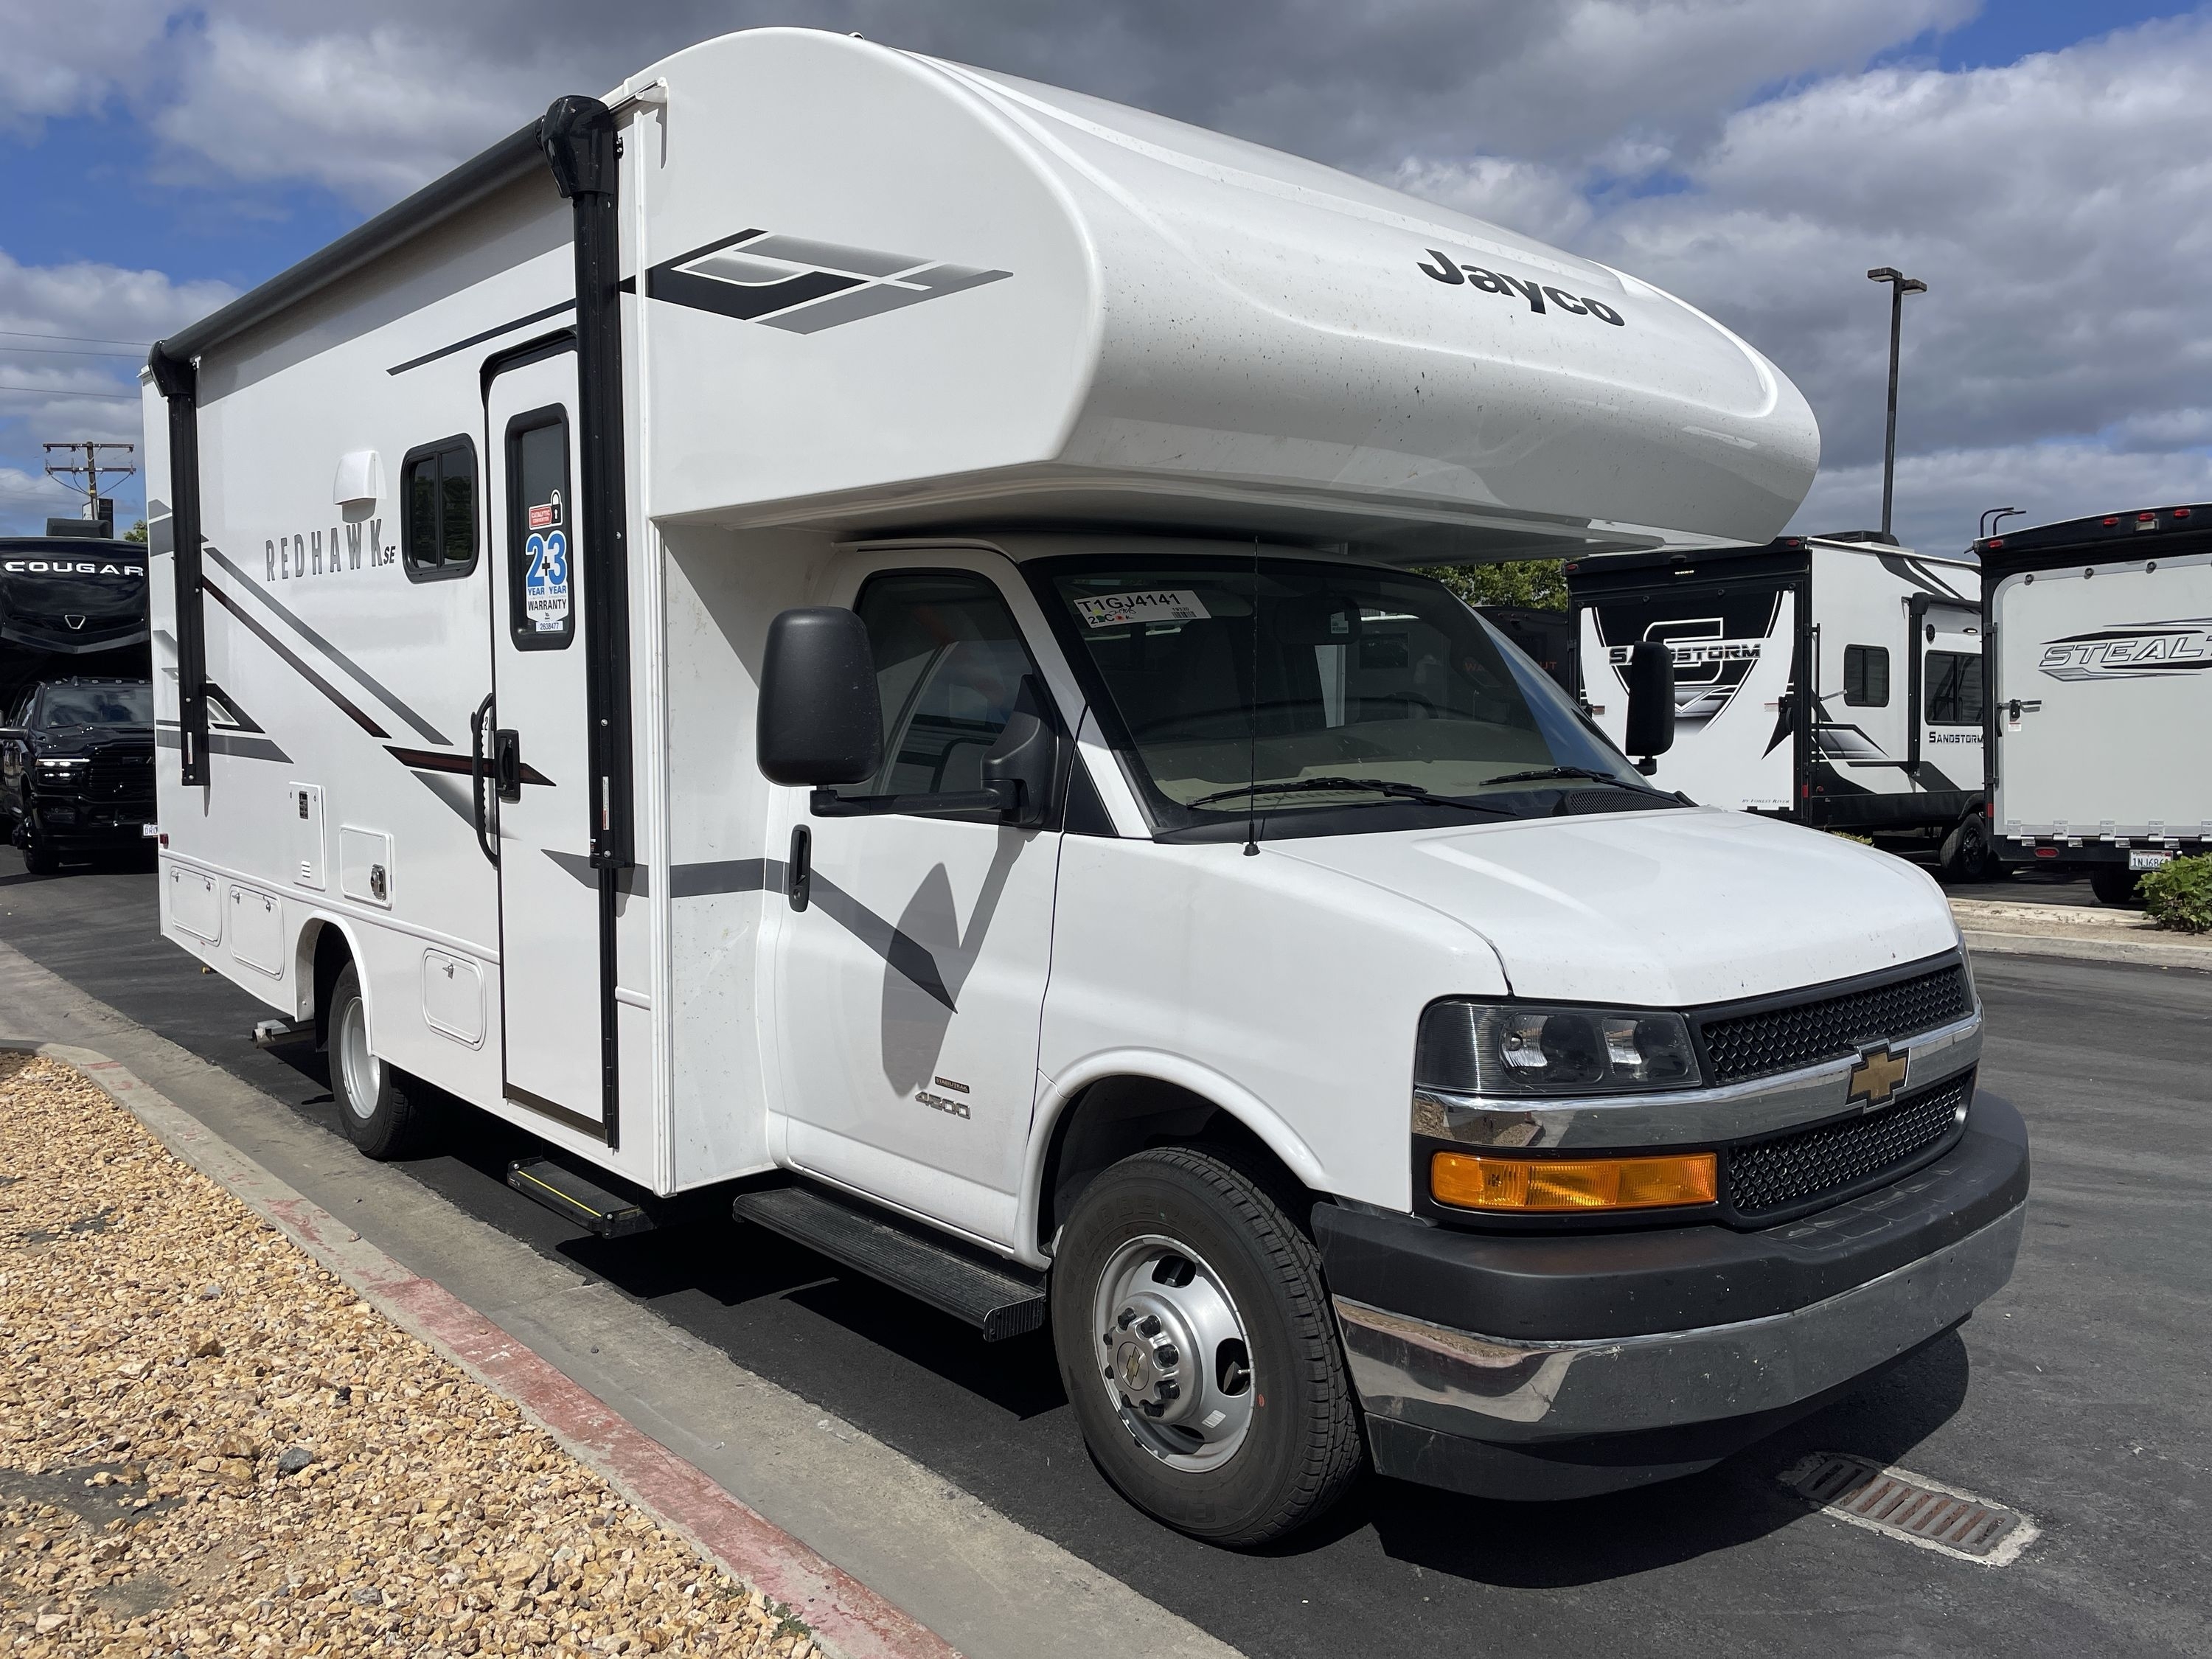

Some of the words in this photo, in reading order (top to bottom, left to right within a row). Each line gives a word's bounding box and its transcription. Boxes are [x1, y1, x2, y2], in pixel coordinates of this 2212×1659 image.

[1416, 248, 1625, 327] Jayco
[265, 519, 383, 581] REDHAWK
[383, 546, 396, 565] SE
[4, 560, 144, 577] COUGAR
[528, 588, 545, 596] YEAR
[549, 585, 566, 594] YEAR
[528, 599, 567, 611] WARRANTY
[1077, 593, 1181, 613] T1GJ4141
[2039, 635, 2212, 667] STEAL
[914, 1091, 971, 1120] 4500
